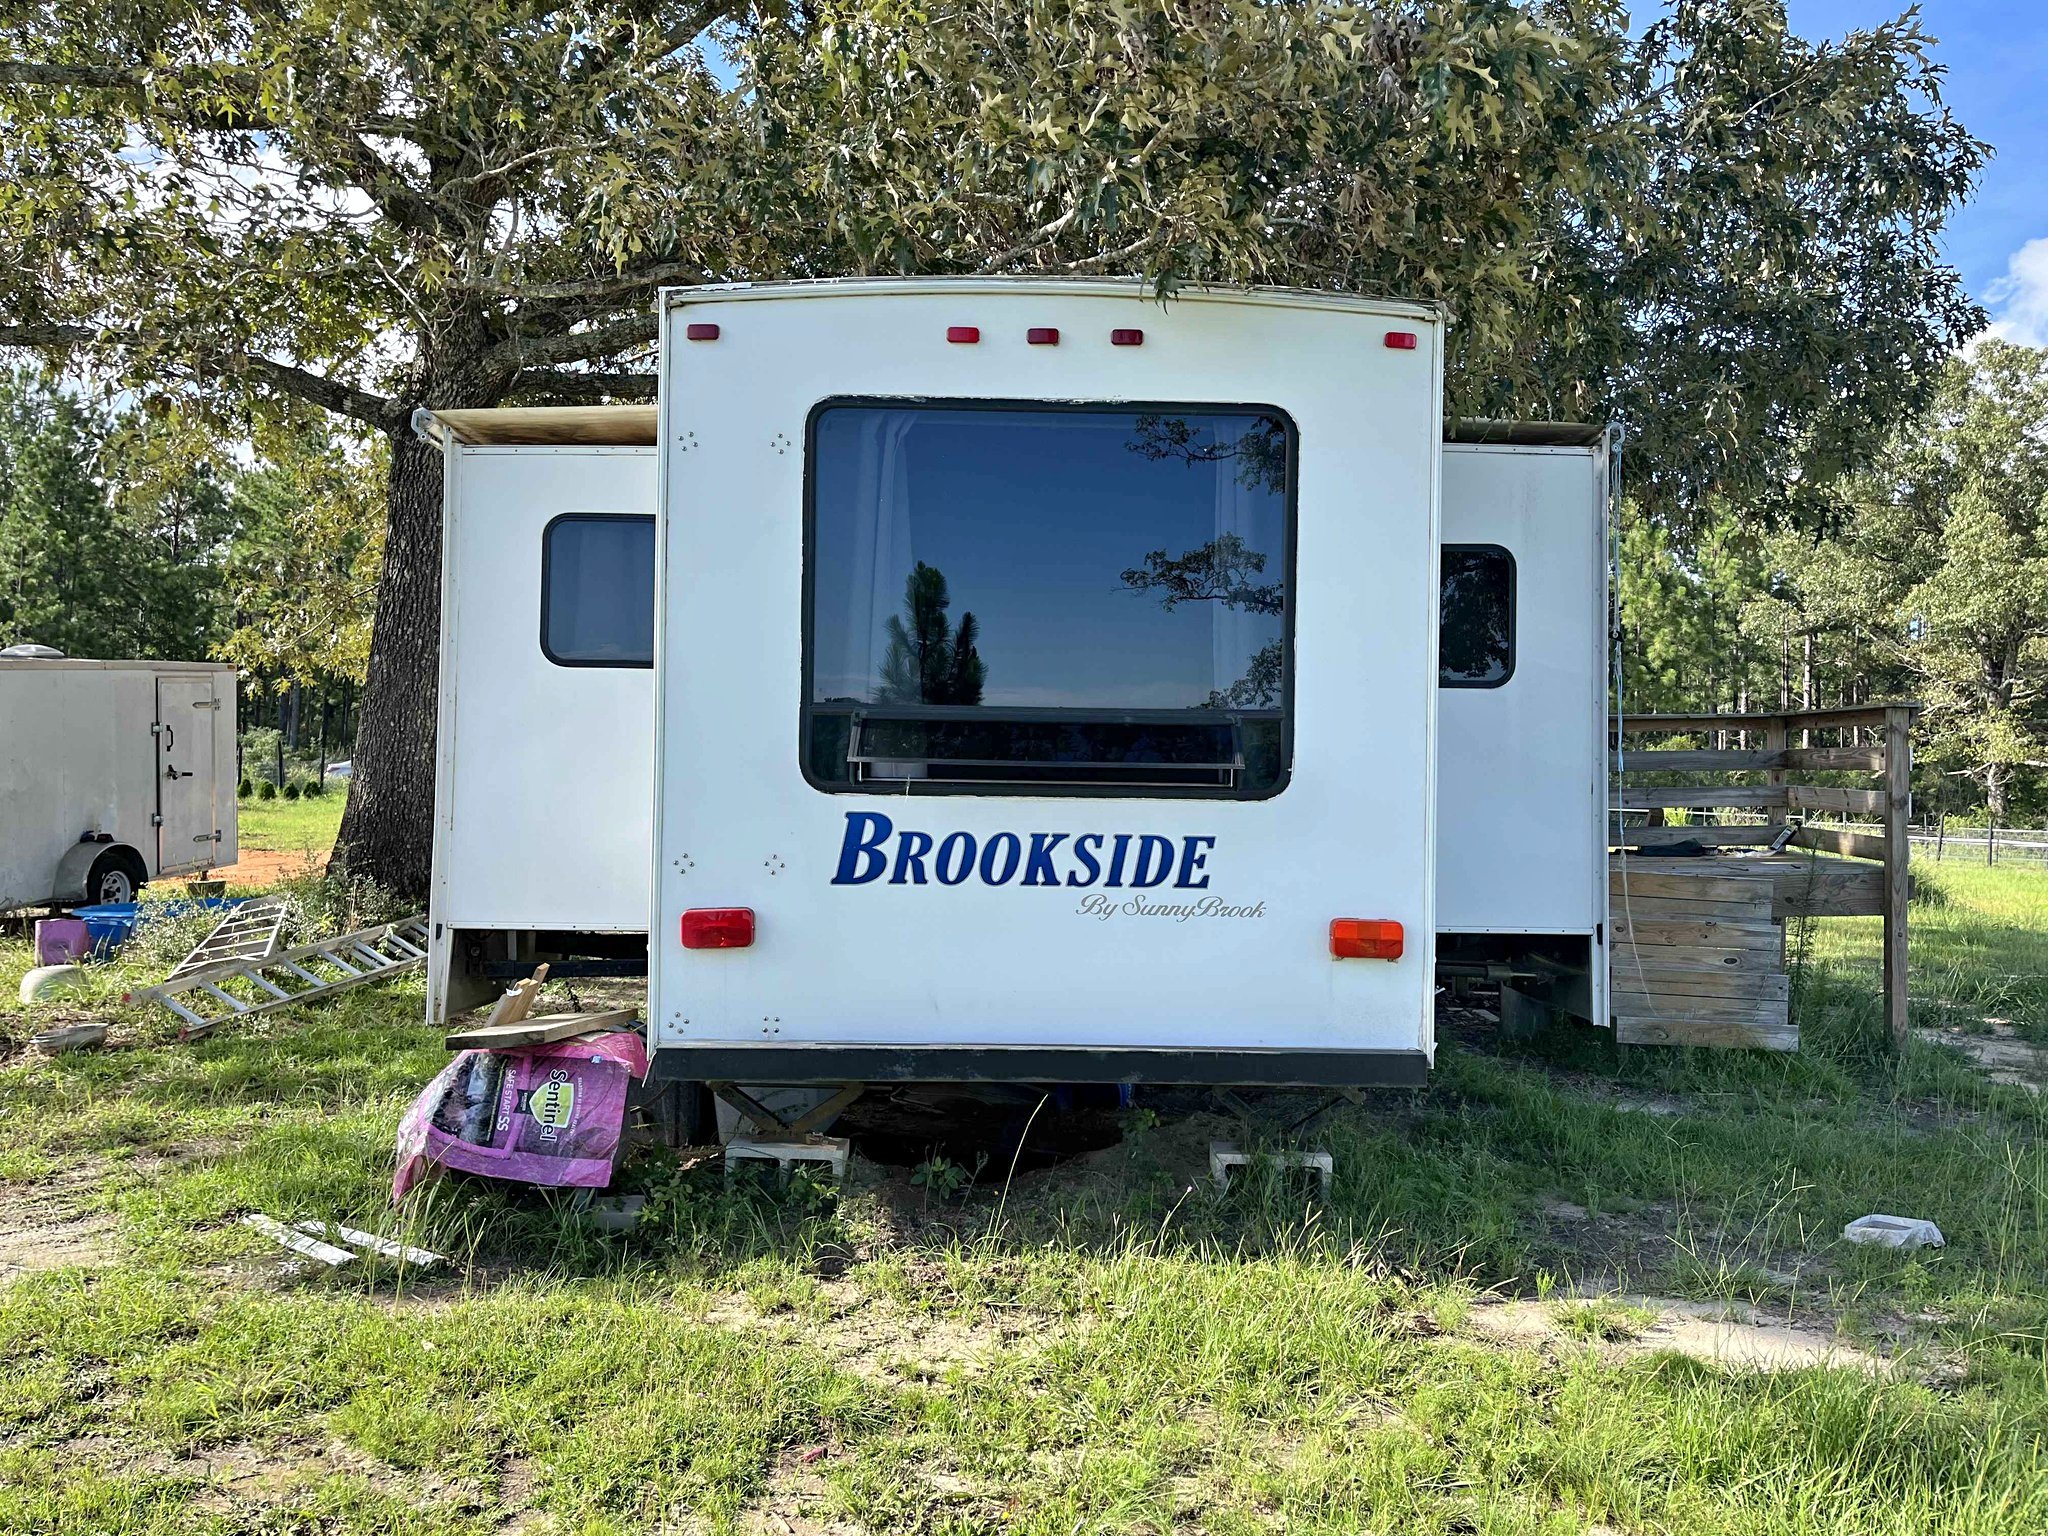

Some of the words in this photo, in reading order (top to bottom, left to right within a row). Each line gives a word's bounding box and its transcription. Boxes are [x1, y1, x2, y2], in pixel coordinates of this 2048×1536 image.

[830, 810, 1216, 890] BROOKSIDE
[1075, 893, 1118, 921] By
[1120, 894, 1268, 923] SunnyBrook
[505, 1069, 517, 1090] SAFE
[501, 1090, 513, 1115] START
[540, 1069, 568, 1143] Sentinel
[496, 1115, 510, 1132] SS
